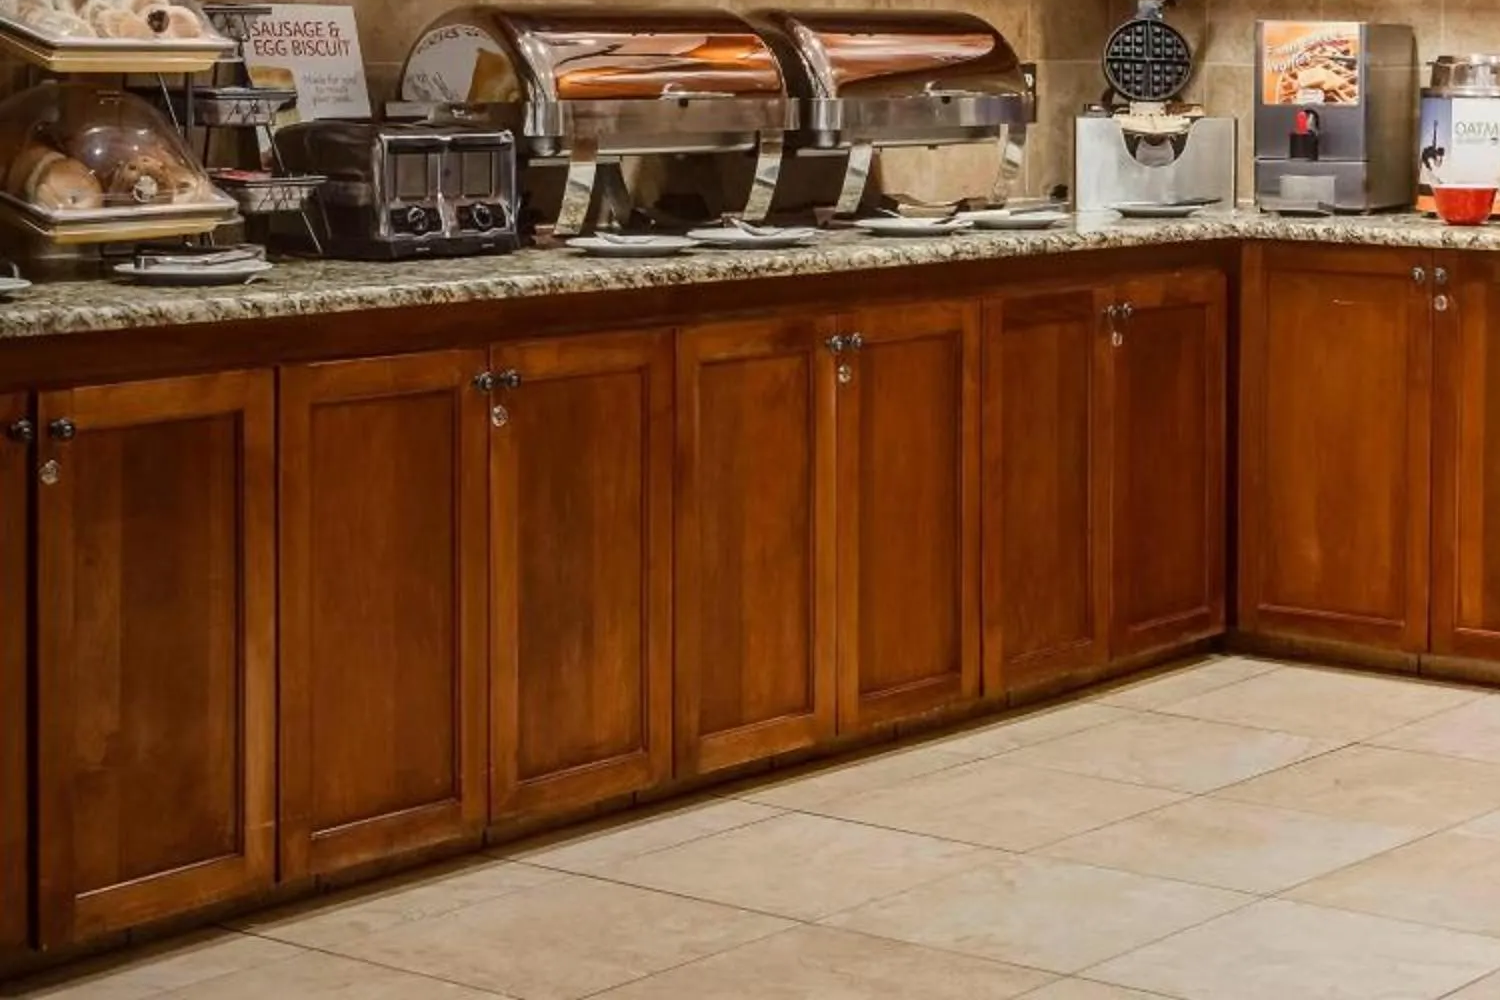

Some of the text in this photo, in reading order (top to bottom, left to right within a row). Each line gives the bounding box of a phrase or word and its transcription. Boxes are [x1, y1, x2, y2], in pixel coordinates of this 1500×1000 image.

[251, 21, 341, 38] SAUSAGE &
[253, 40, 351, 57] EGG BISCUIT
